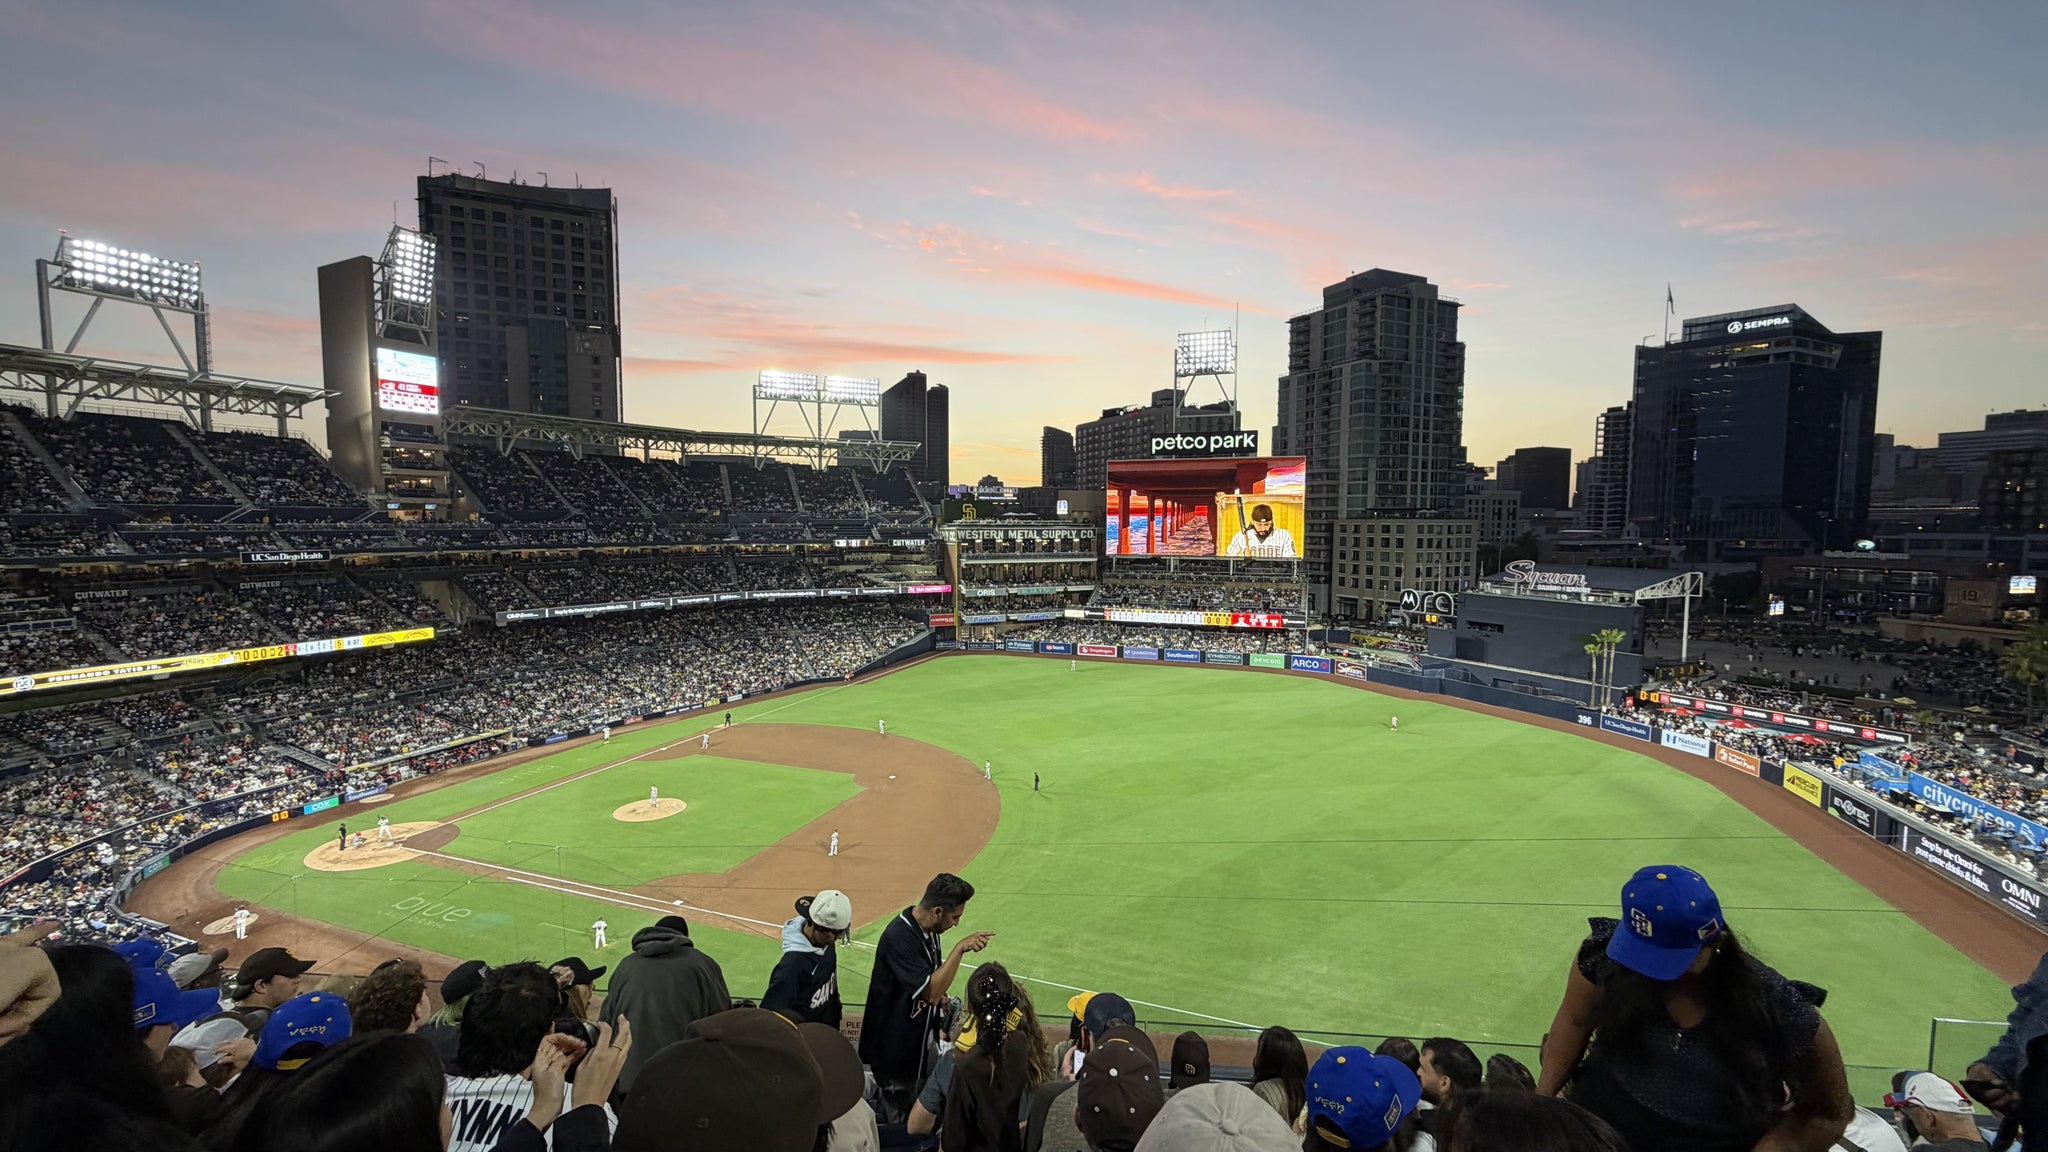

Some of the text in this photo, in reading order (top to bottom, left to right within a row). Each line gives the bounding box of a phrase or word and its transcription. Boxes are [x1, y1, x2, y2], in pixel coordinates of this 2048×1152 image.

[1744, 316, 1790, 330] SEMPRA
[1152, 433, 1255, 455] petco park
[957, 530, 1004, 540] WESTERN
[1008, 530, 1040, 540] METAL
[1042, 529, 1077, 540] SUPPLY
[1080, 529, 1096, 540] CO.
[300, 552, 323, 560] Health
[1503, 560, 1588, 589] Sycuan
[74, 589, 129, 600] CUTWATER
[977, 588, 996, 597] ORIS
[1166, 652, 1195, 660] Southwest
[1292, 659, 1320, 669] ARCO
[48, 669, 111, 683] FERNANDO
[113, 665, 144, 675] TATIS
[1578, 715, 1592, 725] 396
[1677, 736, 1706, 750] National
[1795, 775, 1819, 791] MERCURY
[311, 800, 330, 811] COX
[1833, 796, 1871, 823] EVOTEK
[1920, 836, 1936, 851] Stop
[1943, 847, 1955, 860] the
[1954, 853, 1973, 870] Omni
[1972, 863, 1984, 876] for
[1945, 860, 1966, 879] drinks
[2001, 879, 2041, 909] OMNI
[392, 891, 473, 922] blue
